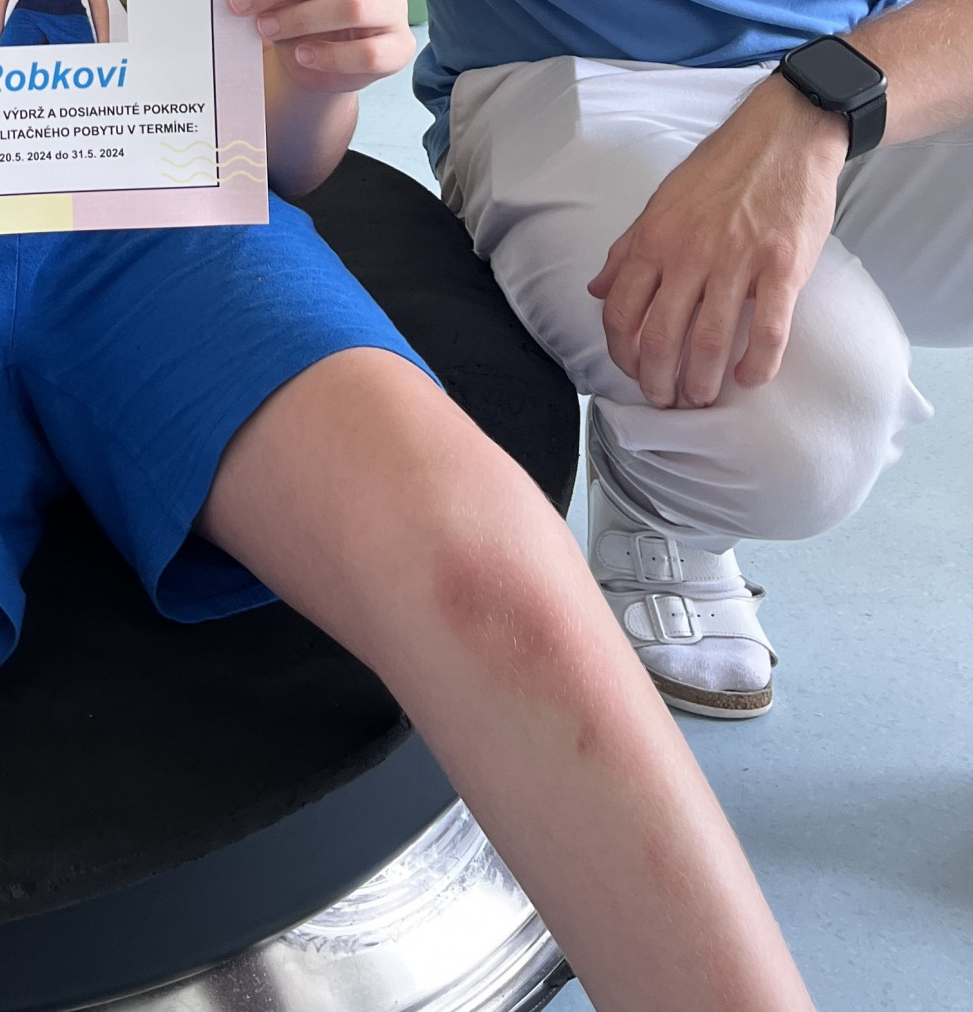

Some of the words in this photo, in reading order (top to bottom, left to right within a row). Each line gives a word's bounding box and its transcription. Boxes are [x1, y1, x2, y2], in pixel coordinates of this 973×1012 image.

[3, 106, 45, 121] VÝDRŽ
[47, 108, 57, 119] A
[59, 102, 140, 119] DOSIAHNUTÉ
[143, 103, 206, 115] POKROKY
[73, 125, 124, 137] POBYTU
[127, 124, 136, 135] V
[139, 121, 198, 135] TERMÍNE:
[0, 152, 25, 162] 20.5.
[27, 150, 53, 161] 2024
[55, 150, 69, 160] do
[71, 150, 97, 159] 31.5.
[99, 148, 125, 158] 2024
